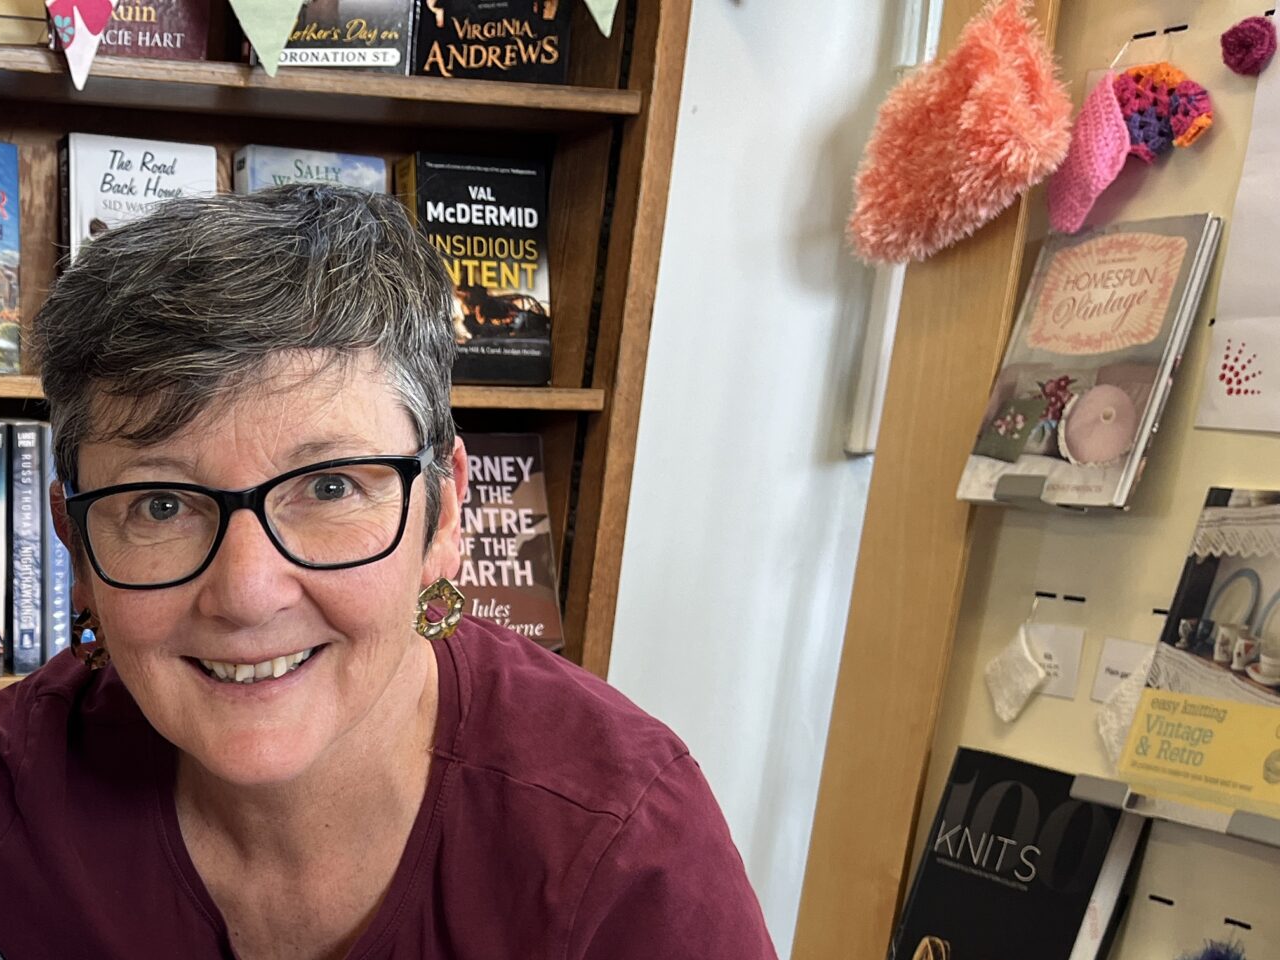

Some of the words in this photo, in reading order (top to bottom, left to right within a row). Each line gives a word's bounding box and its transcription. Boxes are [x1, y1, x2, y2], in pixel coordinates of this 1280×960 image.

[138, 31, 185, 48] HART
[289, 22, 340, 41] other's
[342, 18, 378, 46] Day
[380, 30, 399, 40] on
[451, 17, 534, 41] VIRGINIA
[278, 51, 367, 62] ORONATION
[424, 36, 559, 77] ANDREWS
[110, 150, 132, 172] The
[140, 151, 177, 176] Road
[294, 159, 342, 181] SALLY
[100, 173, 137, 195] Back
[144, 178, 182, 199] Home
[468, 185, 496, 202] VAL
[426, 201, 539, 228] McDERMID
[442, 258, 538, 289] NTENT
[1063, 267, 1158, 292] HOMESPUN
[1052, 288, 1148, 331] Vintage
[21, 454, 32, 484] RUSS
[468, 456, 534, 482] RNEY
[477, 485, 514, 504] THE
[21, 490, 32, 536] THOMAS
[460, 508, 535, 534] NTRE
[480, 538, 518, 556] THE
[451, 560, 534, 587] ARTH
[472, 598, 510, 618] Jules
[1150, 698, 1179, 713] easy
[1181, 699, 1227, 723] knitting
[1146, 714, 1214, 746] Vintage
[1135, 737, 1152, 757] &
[1156, 740, 1204, 767] Retro
[934, 820, 1041, 882] KNITS
